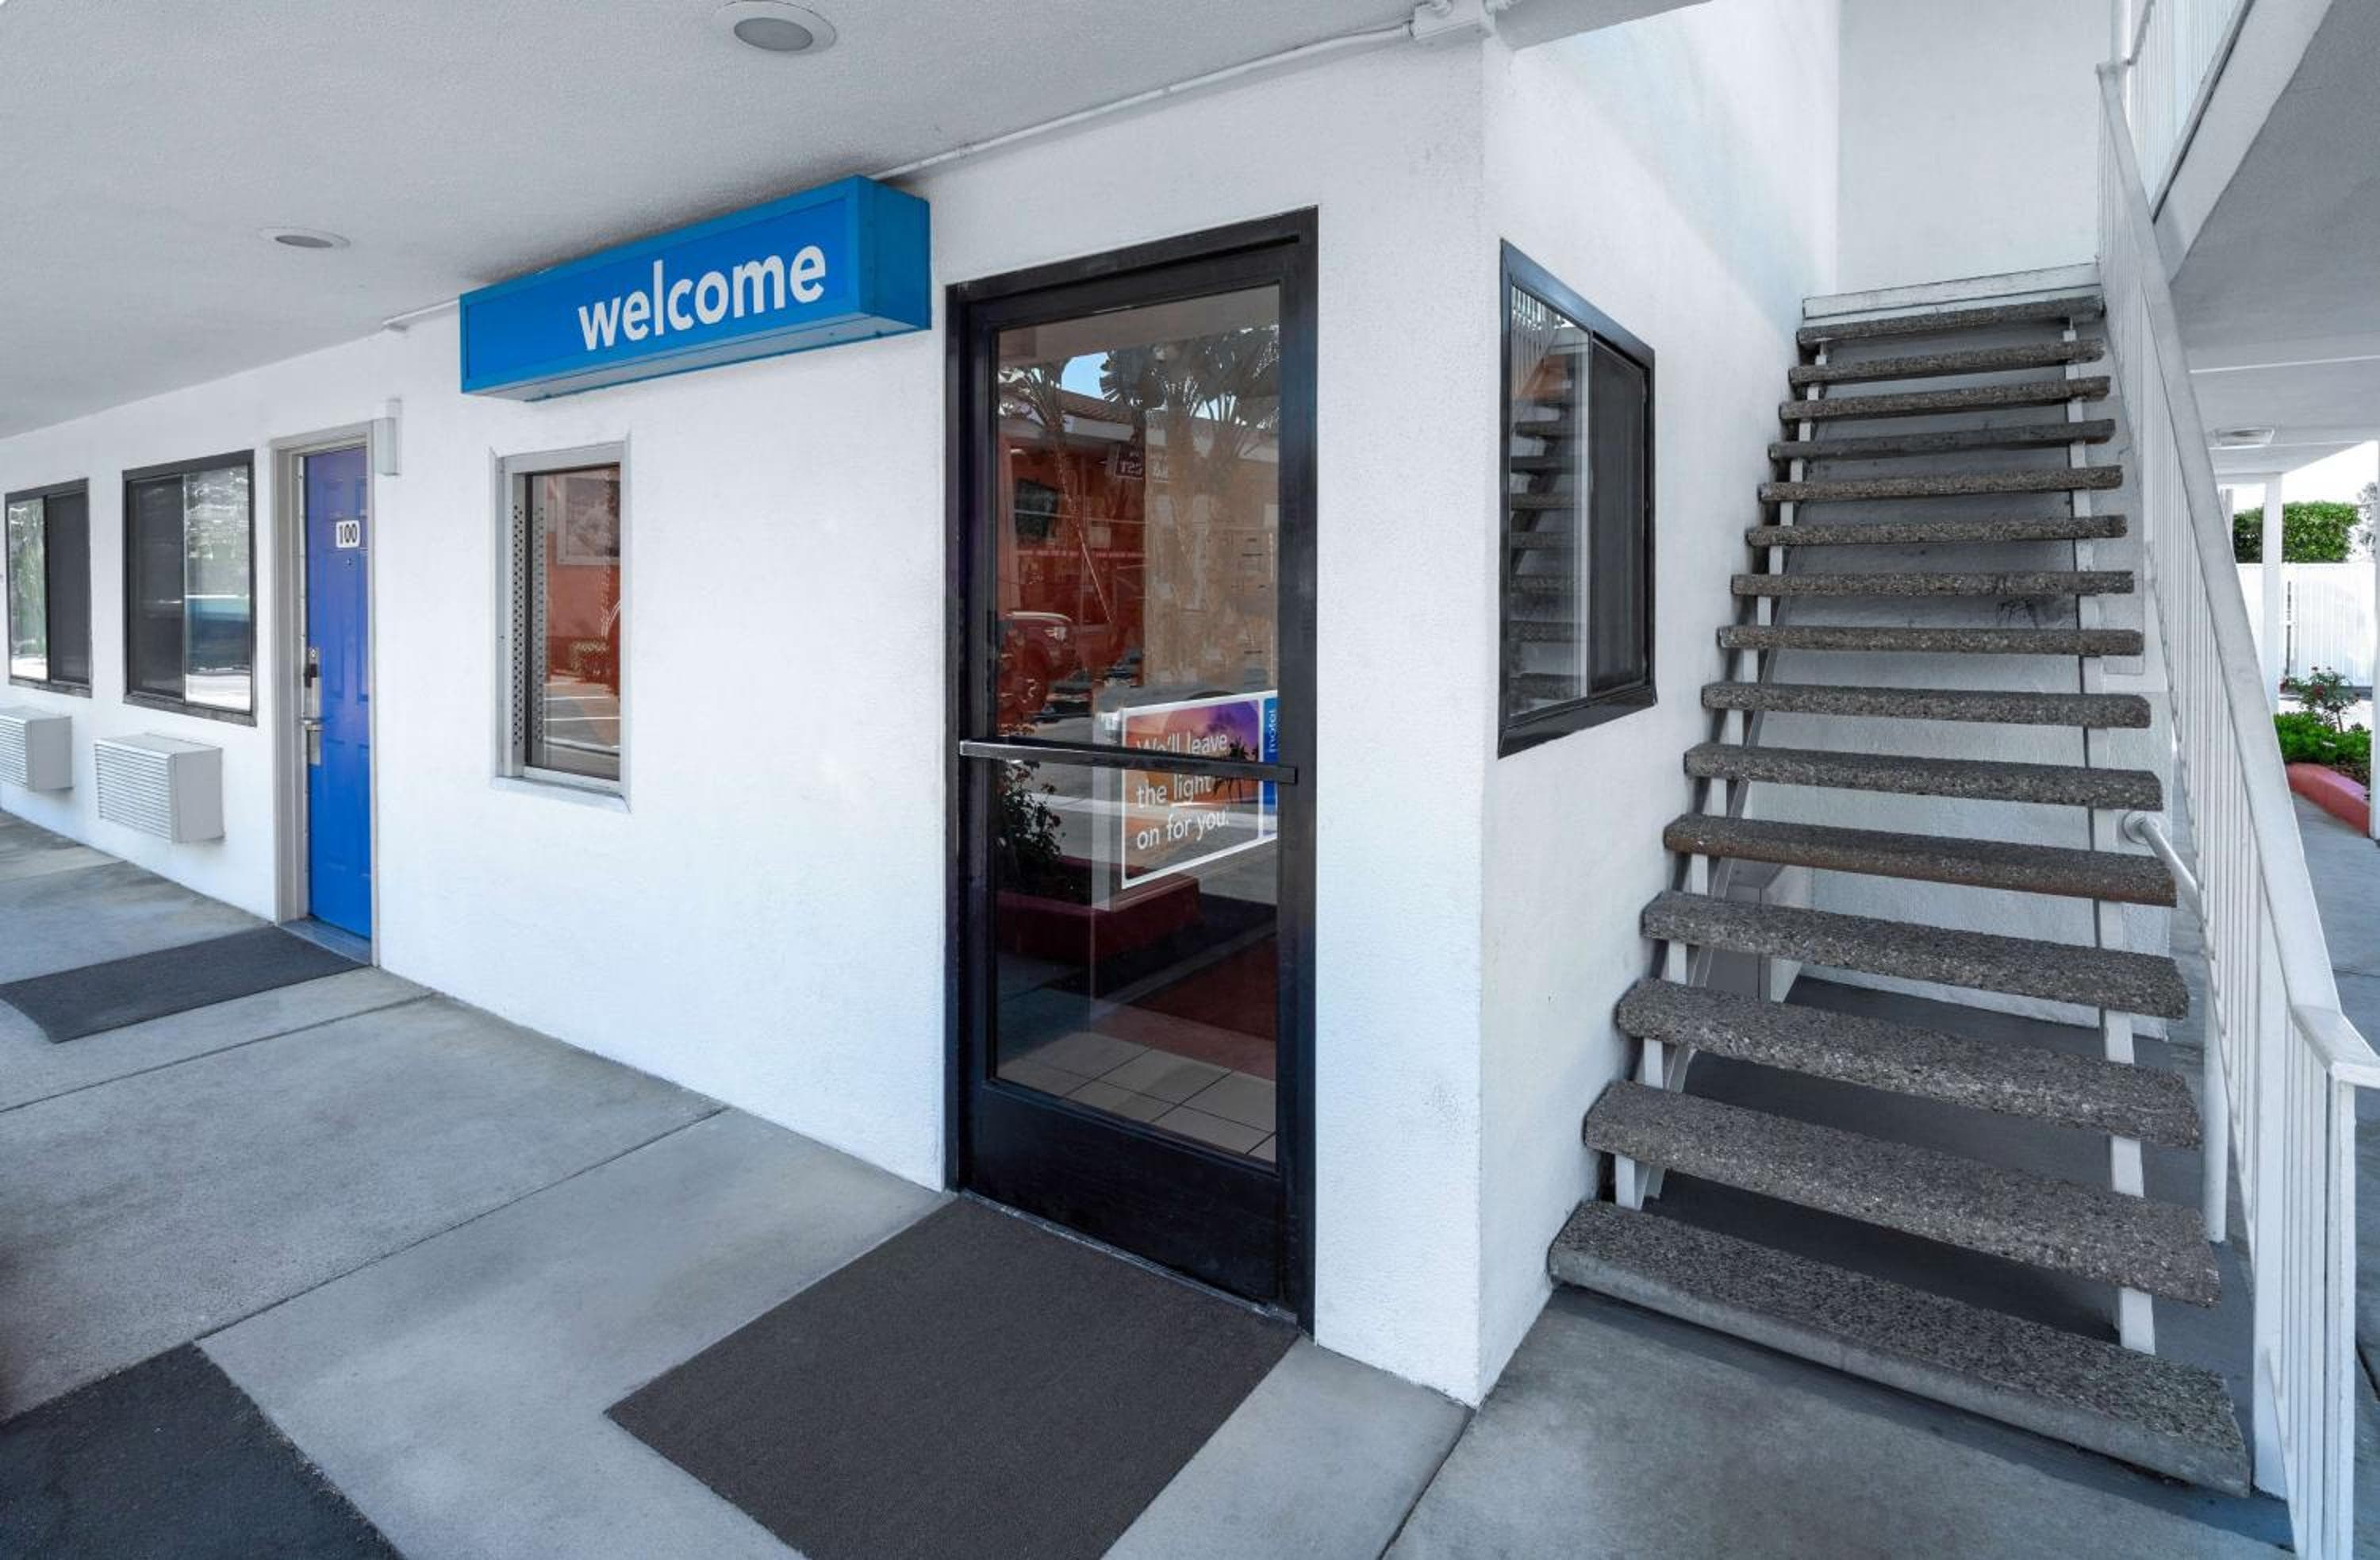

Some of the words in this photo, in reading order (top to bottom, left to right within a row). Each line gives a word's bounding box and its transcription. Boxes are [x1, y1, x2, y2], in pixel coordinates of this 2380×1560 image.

[578, 244, 826, 351] welcome
[340, 524, 357, 544] 100
[1188, 730, 1227, 755] leave
[1136, 778, 1167, 808] the
[1173, 774, 1213, 801] light
[1137, 827, 1159, 850] on
[1166, 813, 1192, 842] for
